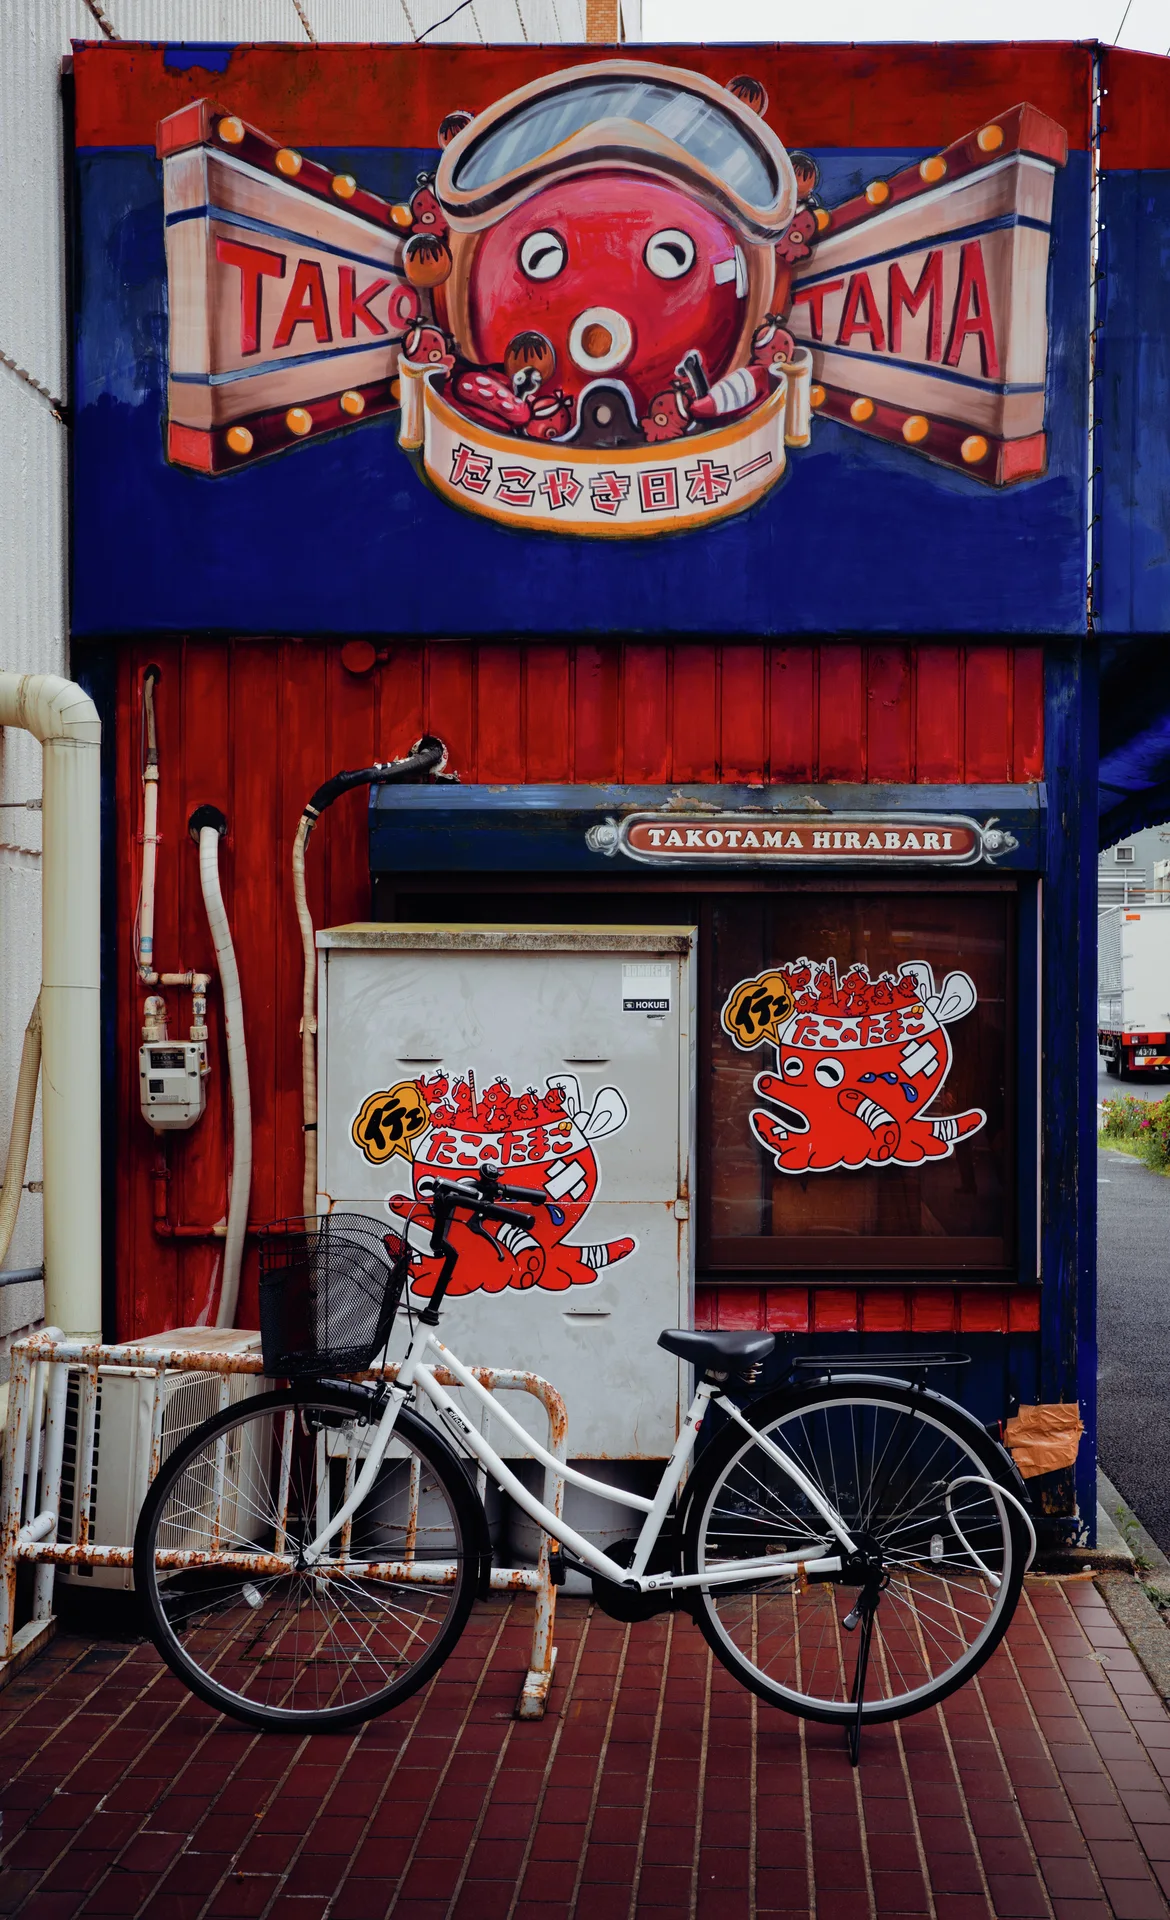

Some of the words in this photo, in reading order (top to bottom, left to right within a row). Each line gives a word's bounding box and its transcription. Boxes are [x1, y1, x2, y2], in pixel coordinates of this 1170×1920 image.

[216, 236, 421, 357] TAKO
[791, 239, 1001, 378] TAMA
[449, 442, 773, 516] たこやき日本一
[647, 828, 800, 849] TAKOTAMA
[812, 830, 953, 851] HIRABARI
[635, 1001, 668, 1009] HOKUEI
[791, 1005, 926, 1048] たこのたまご
[426, 1121, 573, 1165] たこのたまご
